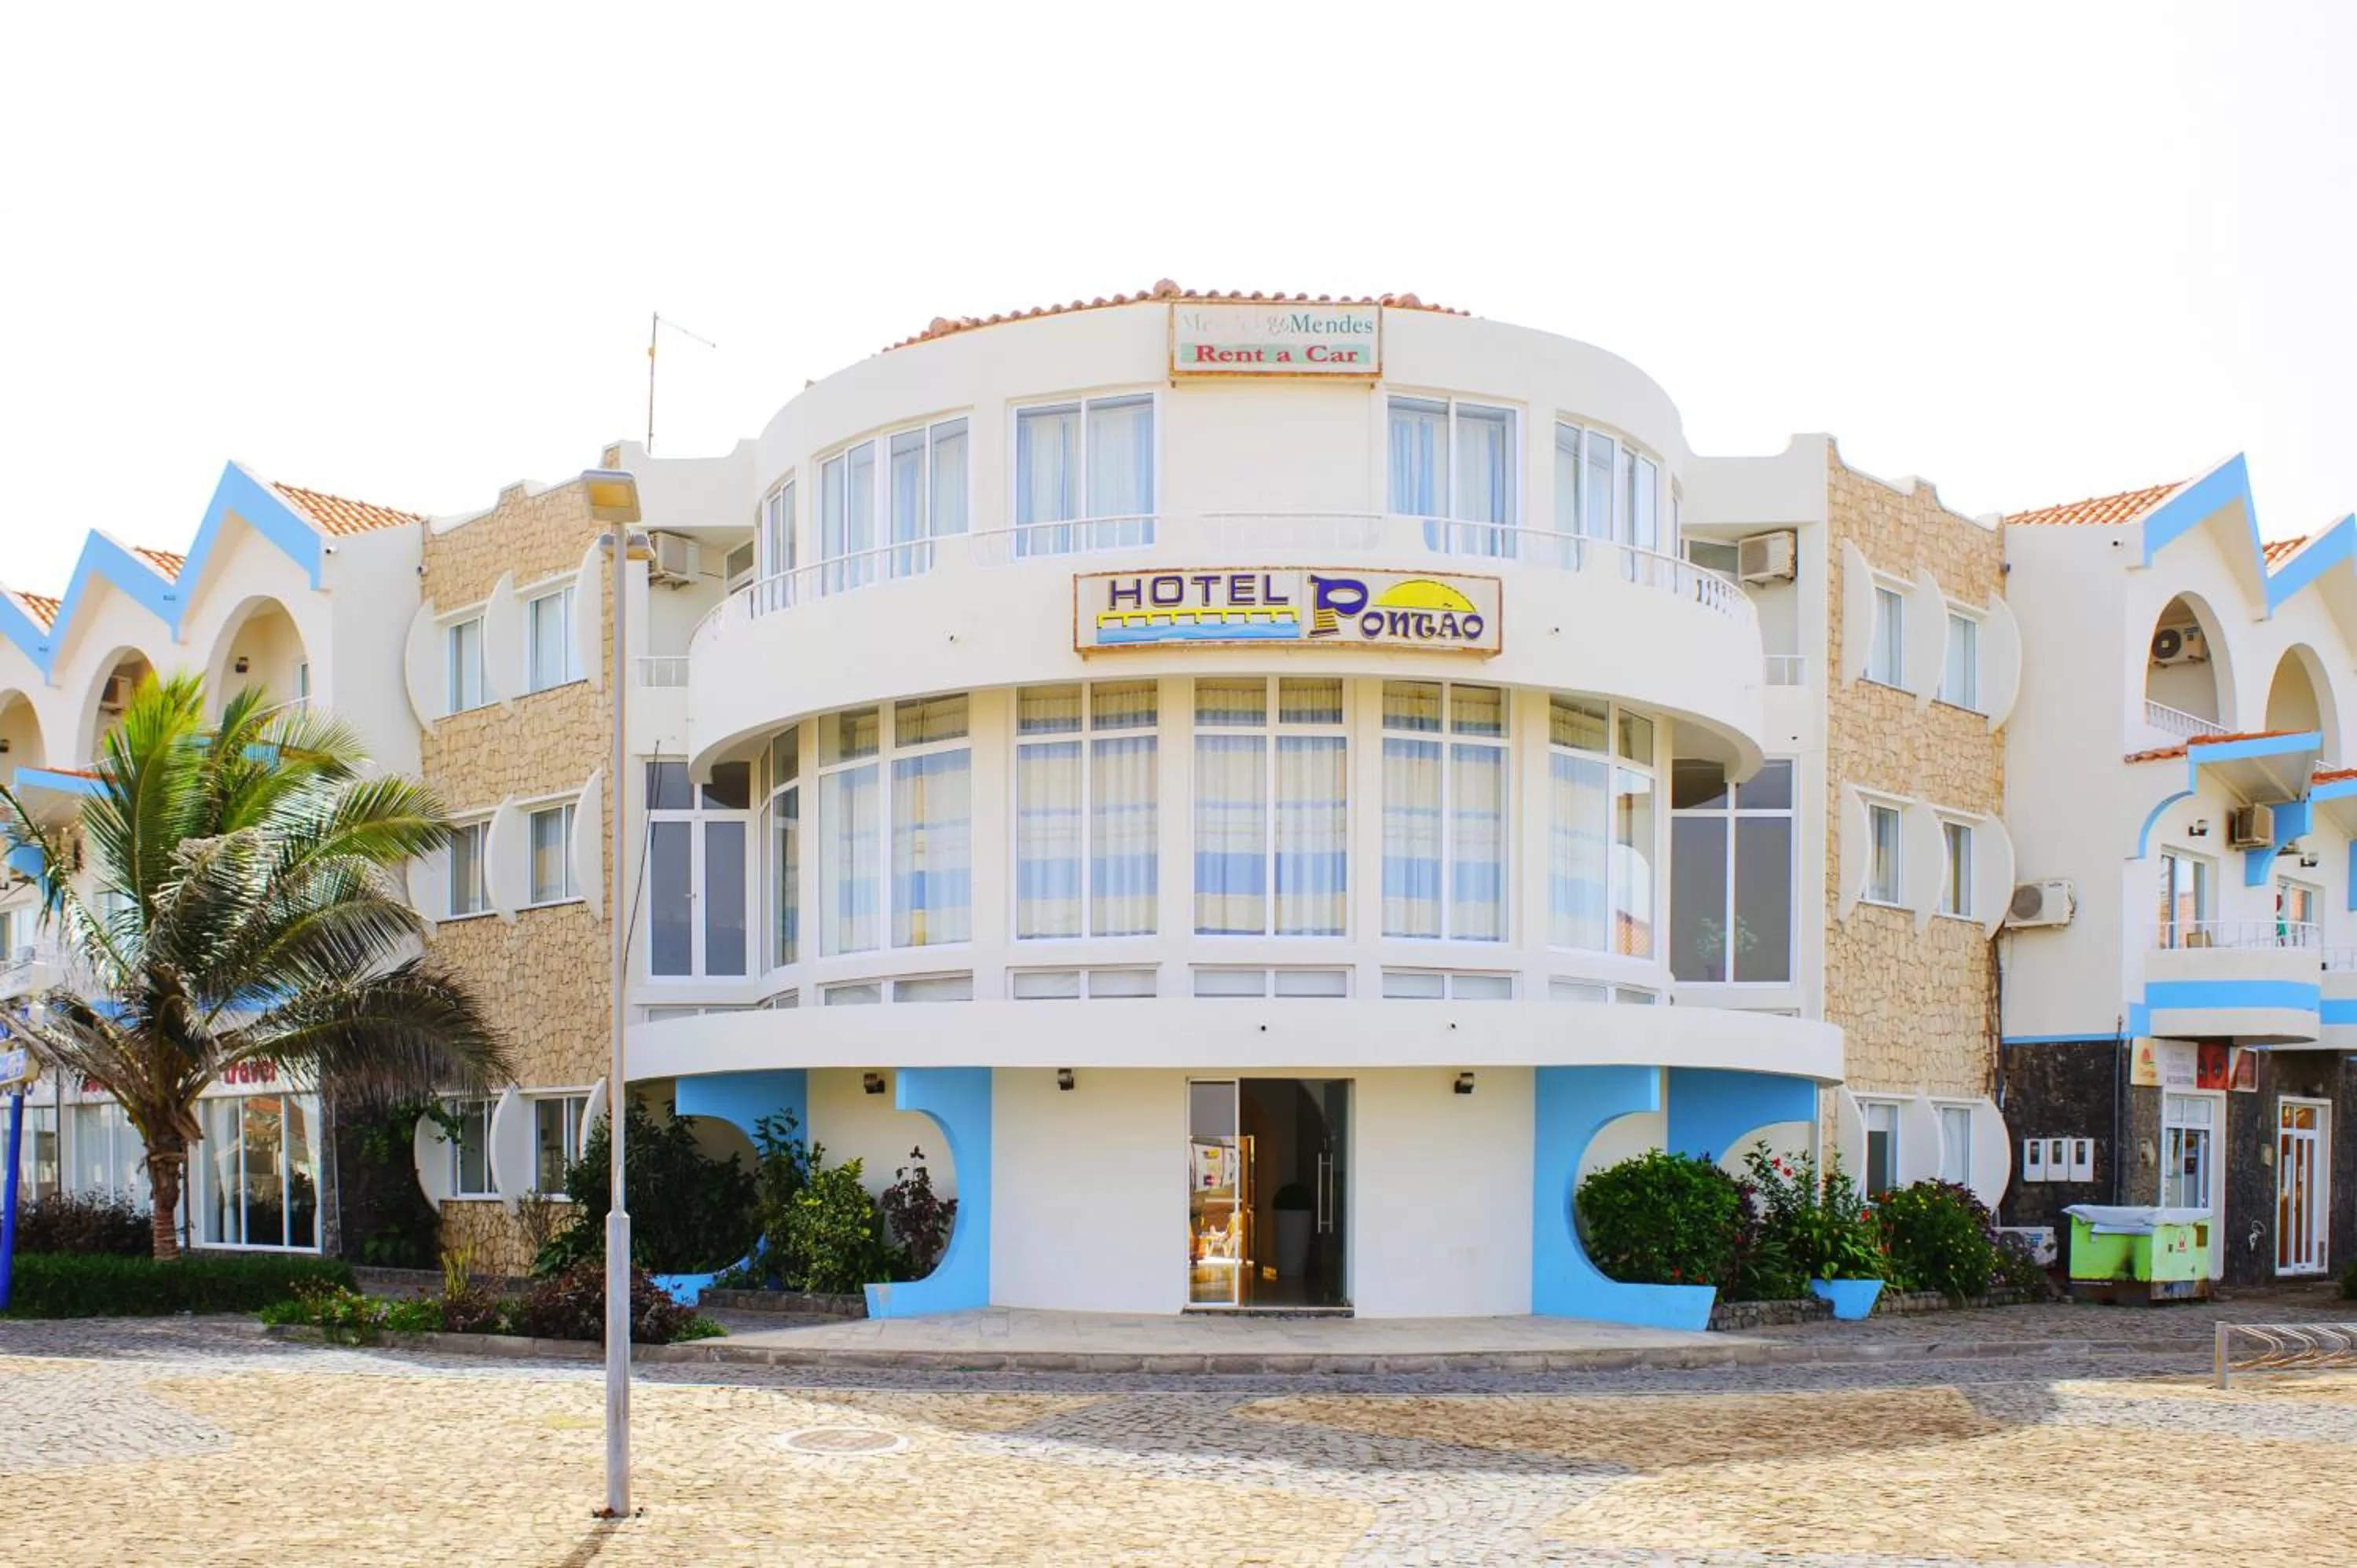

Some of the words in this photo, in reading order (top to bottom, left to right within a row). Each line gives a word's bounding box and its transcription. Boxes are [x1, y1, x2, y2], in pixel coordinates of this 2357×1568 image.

[1194, 345, 1263, 363] Rent
[1276, 350, 1291, 362] a
[1306, 345, 1358, 363] Car
[1109, 574, 1289, 610] HOTEL
